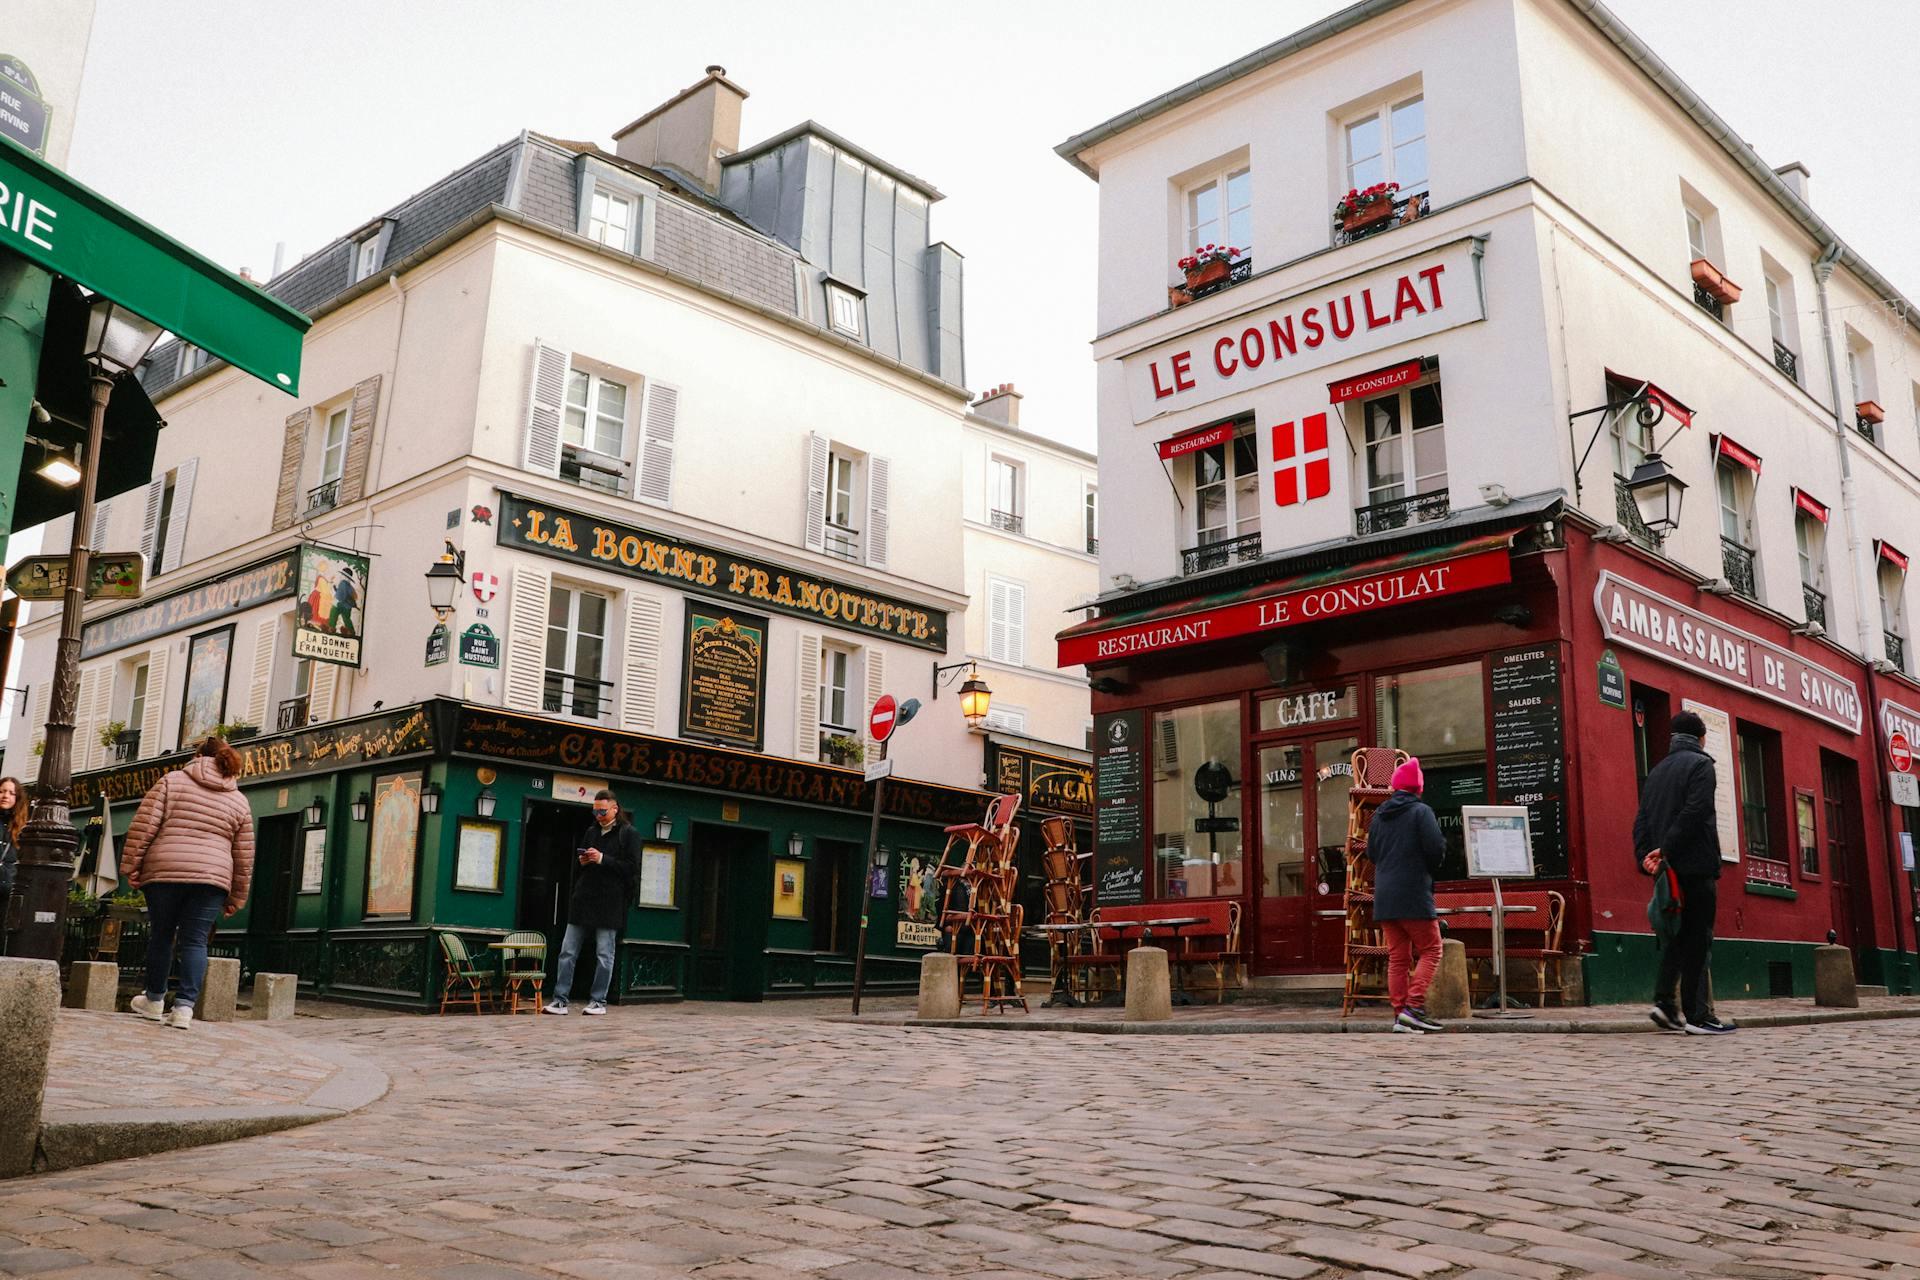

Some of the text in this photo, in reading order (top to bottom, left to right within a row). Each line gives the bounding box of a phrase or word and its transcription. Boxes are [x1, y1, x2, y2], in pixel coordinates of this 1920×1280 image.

[1, 91, 21, 112] RUE
[1150, 264, 1445, 400] LE CONSULAT
[1340, 370, 1409, 397] LE CONSULAT
[1170, 431, 1222, 454] RESTAURANT
[525, 510, 928, 640] LA BONNE FRANQUETTE
[113, 605, 164, 642] BONNE
[167, 561, 289, 624] FRANQUETTE
[1098, 566, 1450, 657] RESTAURANT LE CONSULAT
[306, 633, 350, 649] LA BONNE
[474, 639, 486, 647] RUE
[299, 641, 355, 661] FRANQUETTE
[464, 653, 494, 663] RUSTIQUE
[471, 646, 489, 655] SAINT
[1504, 651, 1545, 663] OMELETTES
[1610, 592, 1857, 722] AMBASSADE DE SAVOIE
[1606, 673, 1616, 684] RUE
[1508, 697, 1542, 708] SALADES
[236, 743, 293, 778] ARET
[533, 779, 544, 788] 18
[664, 749, 868, 806] RESTAURANT
[1266, 769, 1296, 784] VINS
[1048, 779, 1060, 795] LA
[1514, 793, 1544, 803] CRÊPES
[905, 923, 935, 934] LA BONNE
